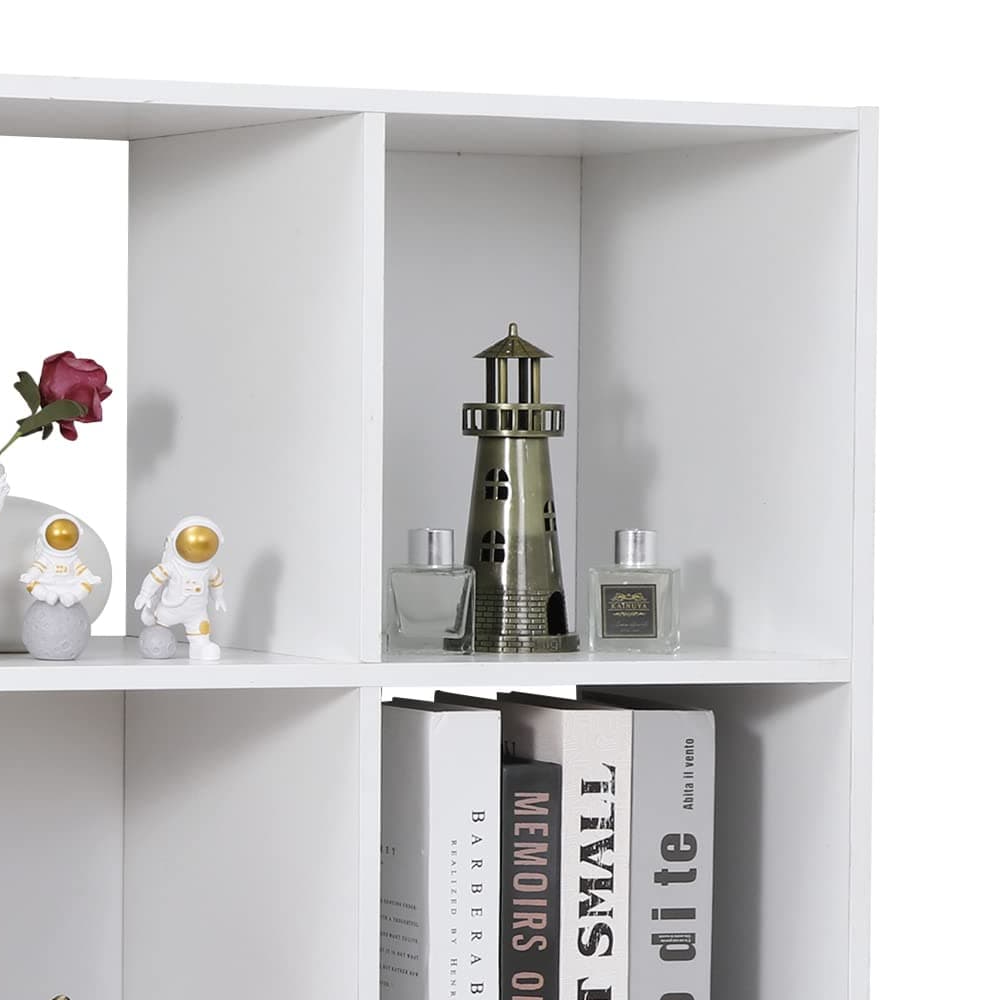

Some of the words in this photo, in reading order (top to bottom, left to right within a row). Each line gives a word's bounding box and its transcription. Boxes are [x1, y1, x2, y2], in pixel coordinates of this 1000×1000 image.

[683, 738, 694, 768] vento
[683, 783, 694, 811] Abita
[512, 792, 549, 951] MEMOIRS
[577, 763, 616, 957] SMALL
[654, 832, 697, 886] te
[651, 907, 696, 961] di
